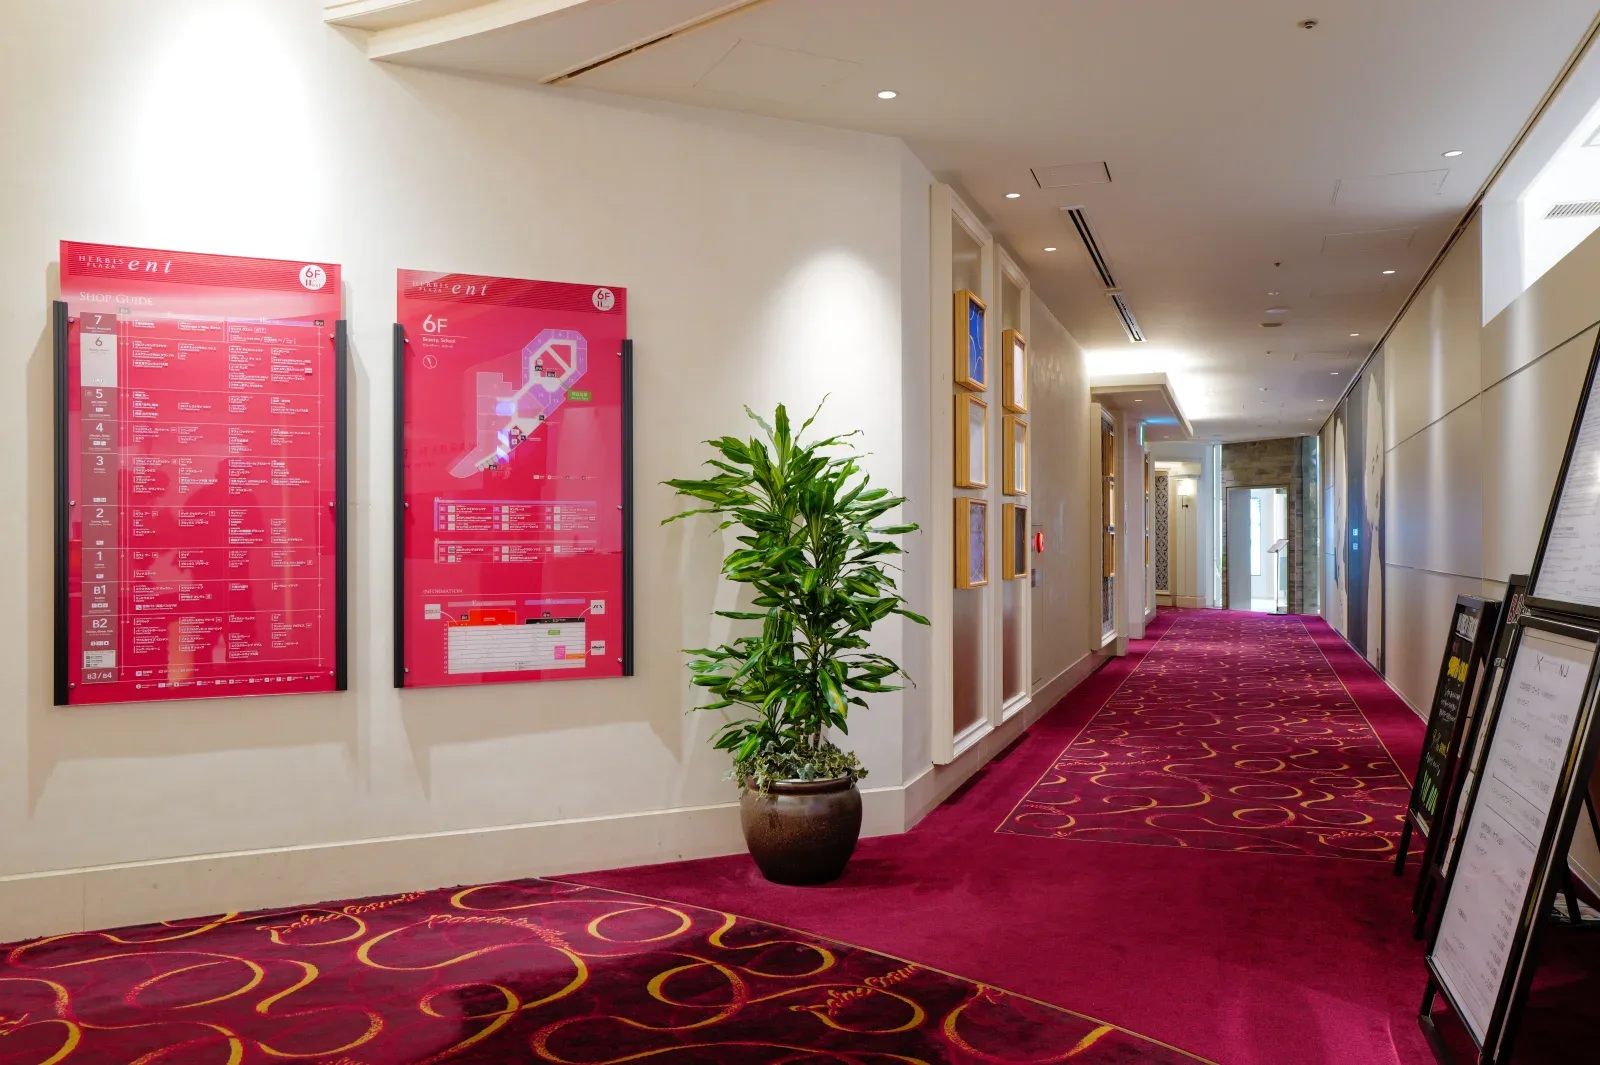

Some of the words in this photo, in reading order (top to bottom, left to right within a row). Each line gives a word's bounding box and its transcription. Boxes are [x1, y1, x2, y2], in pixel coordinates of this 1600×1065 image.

[78, 256, 124, 264] HERBIS
[128, 260, 172, 273] ent
[305, 267, 321, 278] 6F
[452, 284, 488, 296] ent
[597, 290, 610, 300] 6F
[94, 315, 102, 324] 7
[423, 314, 448, 333] 6F
[95, 337, 102, 346] 6
[96, 389, 103, 398] 5
[96, 423, 104, 432] 4
[96, 456, 104, 466] 3
[96, 508, 104, 518] 2
[97, 551, 102, 560] 1
[94, 584, 106, 594] B1
[92, 618, 107, 628] B2
